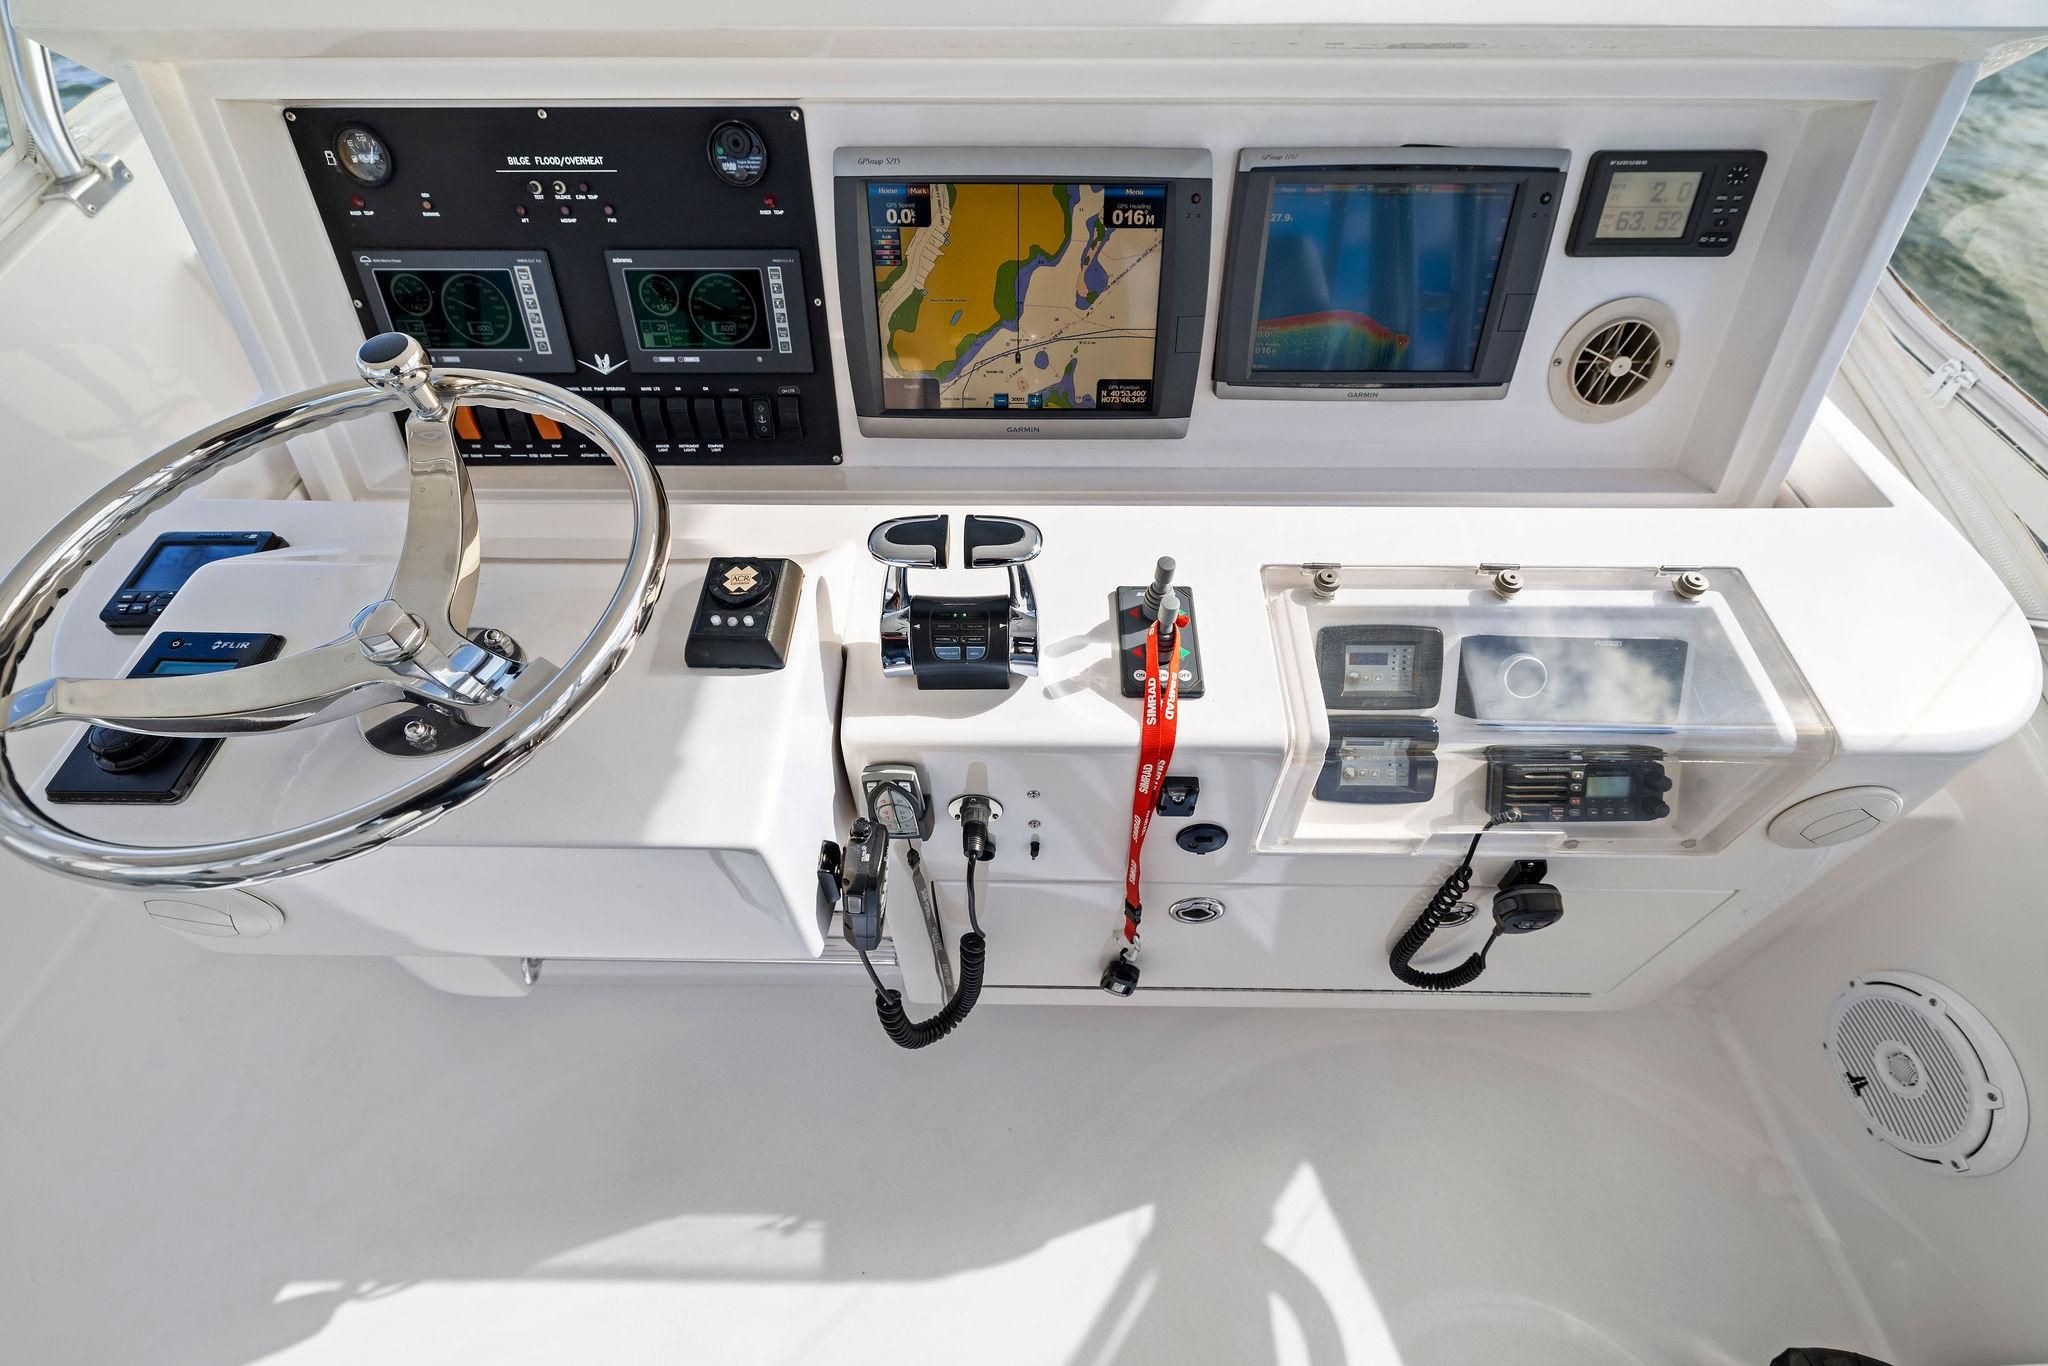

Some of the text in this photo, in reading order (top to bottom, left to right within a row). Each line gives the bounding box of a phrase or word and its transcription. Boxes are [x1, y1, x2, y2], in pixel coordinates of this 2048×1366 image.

[507, 156, 604, 167] BILGE FLOOD/OVERHEAT
[886, 208, 912, 224] 0.0
[219, 641, 251, 649] FLIR
[1135, 671, 1145, 679] ON
[1146, 677, 1157, 726] SIMRAD
[1165, 672, 1178, 720] SIMRAD
[1138, 764, 1153, 795] SIMRAD
